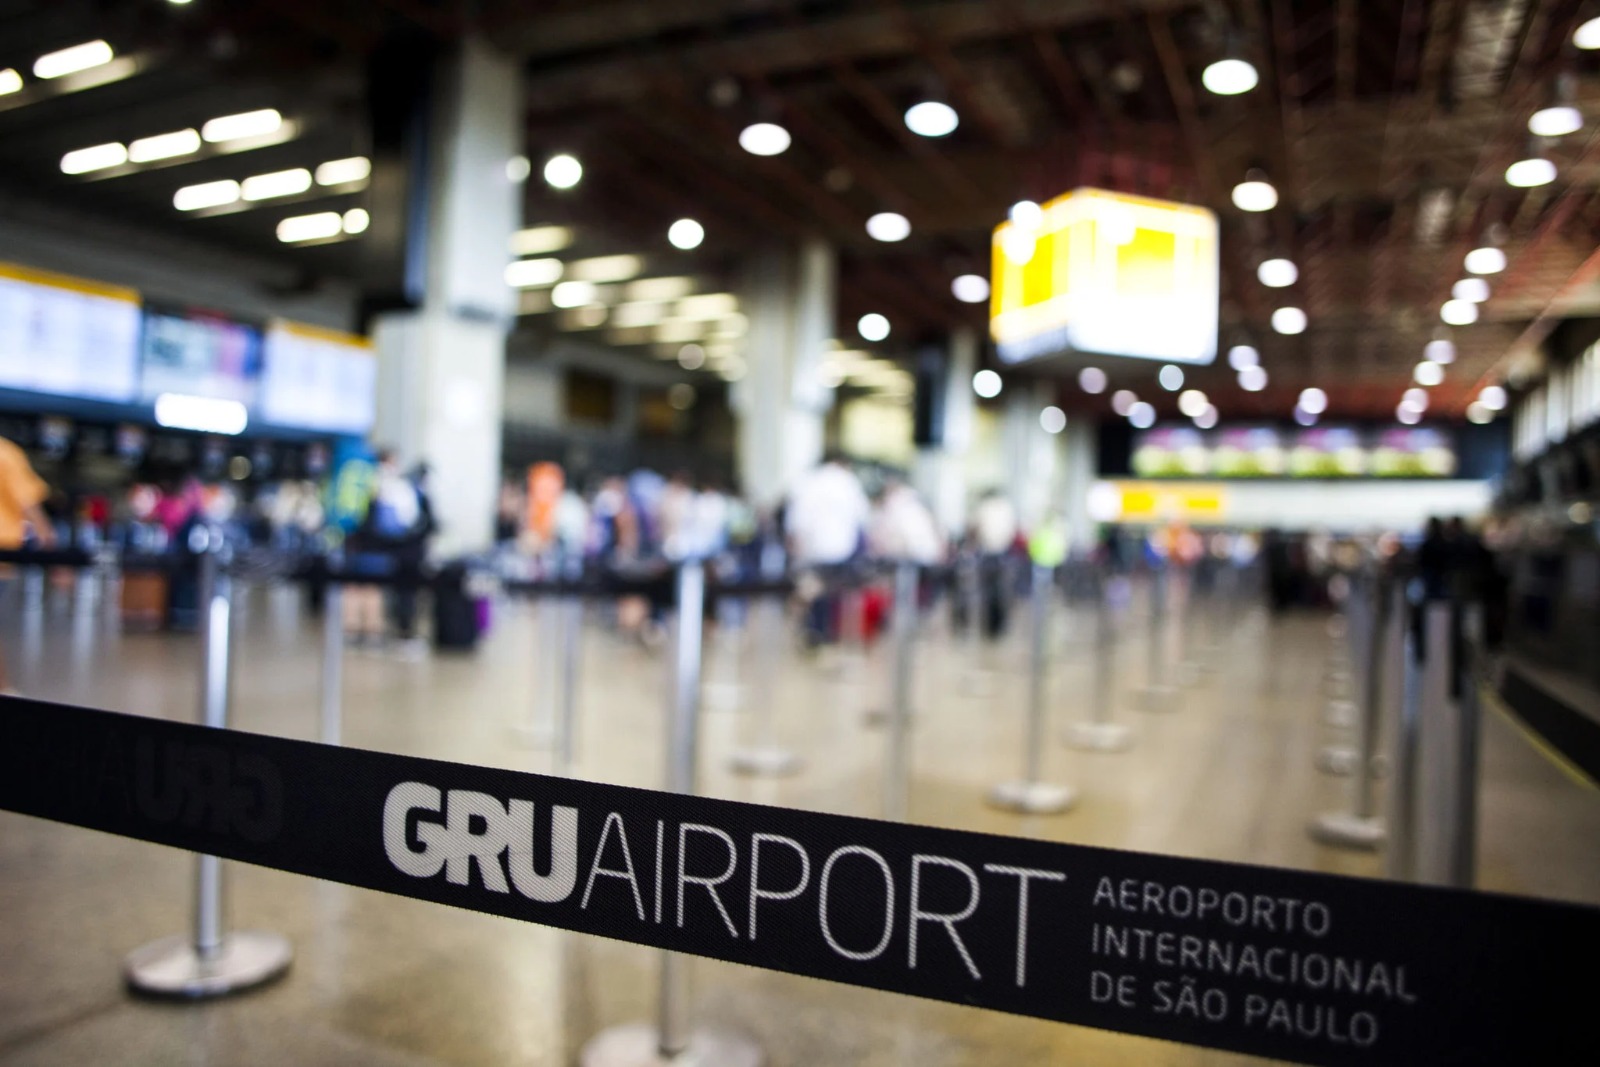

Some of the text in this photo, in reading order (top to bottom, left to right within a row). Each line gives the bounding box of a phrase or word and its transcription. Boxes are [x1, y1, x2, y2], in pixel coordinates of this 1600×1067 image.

[1092, 875, 1331, 937] AEROPORTO
[1091, 922, 1418, 1004] INTERNACIONAL
[1090, 970, 1379, 1046] DE SÃO PAULO
